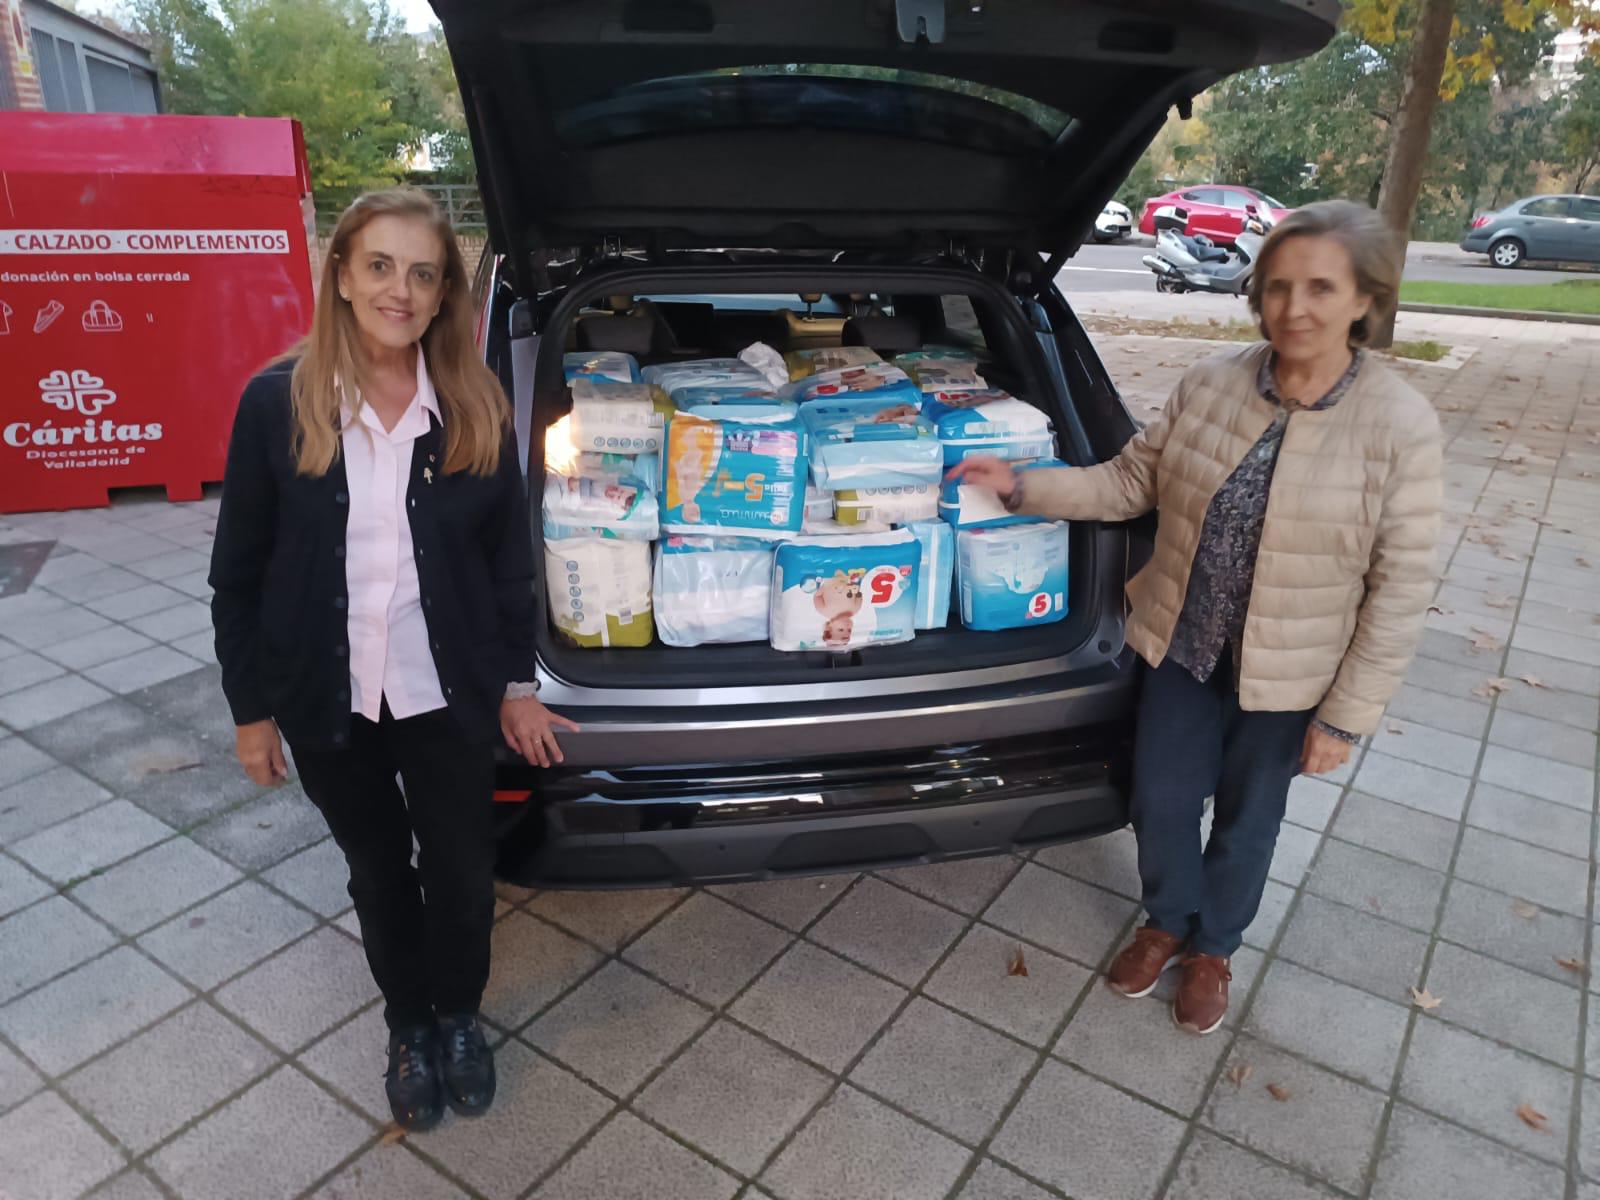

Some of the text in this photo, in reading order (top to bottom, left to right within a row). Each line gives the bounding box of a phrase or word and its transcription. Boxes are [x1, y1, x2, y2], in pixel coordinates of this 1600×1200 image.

[15, 234, 286, 250] CALZADO COMPLEMENTOS
[1, 271, 190, 282] donación en bolsa cerrada
[3, 418, 163, 447] Cáritas
[26, 445, 146, 459] Diocesana de
[44, 456, 130, 469] Valladolid
[871, 572, 896, 603] 5
[1033, 593, 1047, 613] 5
